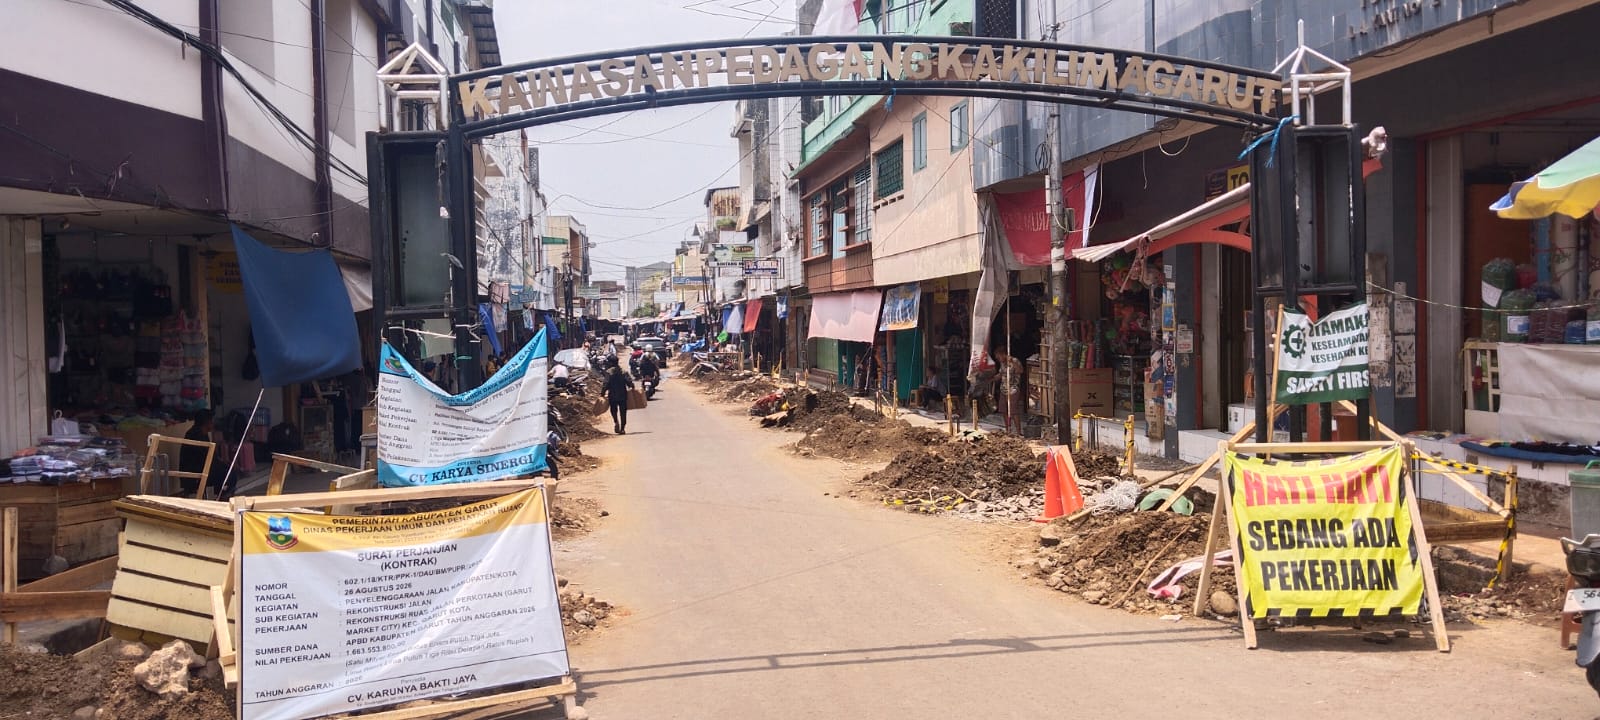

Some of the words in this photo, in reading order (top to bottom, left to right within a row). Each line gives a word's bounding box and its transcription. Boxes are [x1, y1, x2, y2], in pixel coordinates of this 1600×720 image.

[1286, 373, 1334, 394] SAFETY
[1337, 369, 1370, 389] FIRS
[431, 465, 473, 482] KARYA
[476, 453, 534, 475] SINERGI
[1243, 468, 1316, 507] HATI
[1320, 465, 1393, 504] HATI
[332, 517, 400, 525] PEMERINTAH
[402, 509, 462, 523] KABUPATEN
[464, 501, 498, 514] GARUT
[336, 525, 392, 534] PEKERJAAN
[394, 521, 423, 532] UMUM
[425, 519, 445, 528] DAN
[1247, 518, 1348, 551] SEDANG
[1352, 517, 1402, 549] ADA
[357, 550, 392, 562] SURAT
[396, 543, 458, 558] PERJANJIAN
[380, 557, 437, 572] (KONTRAK)
[255, 582, 288, 592] NOMOR
[1260, 559, 1399, 591] PEKERJAAN
[255, 593, 296, 603] TANGGAL
[354, 584, 394, 595] AGUSTUS
[255, 603, 298, 613] KEGIATAN
[345, 590, 424, 605] PENYELENGGARAAN
[425, 587, 450, 597] JALAN
[255, 615, 273, 624] SUB
[275, 612, 318, 622] KEGIATAN
[346, 602, 407, 615] REKONSTRUKSI
[408, 599, 432, 609] JALAN
[255, 623, 308, 634] PEKERJAAN
[346, 612, 407, 625] REKONSTRUKSI
[455, 591, 503, 604] PERKOTAAN
[346, 626, 379, 636] MARKET
[381, 623, 401, 633] CITY)
[449, 605, 471, 615] KOTA
[255, 645, 292, 656] SUMBER
[294, 643, 318, 652] DANA
[346, 637, 368, 646] APBD
[369, 629, 416, 643] KABUPATEN
[447, 614, 473, 625] TAHUN
[474, 609, 518, 620] ANGGARAN
[255, 657, 278, 667] NILAI
[279, 652, 331, 664] PEKERJAAN
[255, 689, 284, 699] TAHUN
[285, 681, 335, 694] ANGGARAN
[347, 693, 364, 704] CV.
[367, 685, 418, 700] KARUNYA
[419, 678, 451, 691] BAKTI
[453, 673, 477, 686] JAYA
